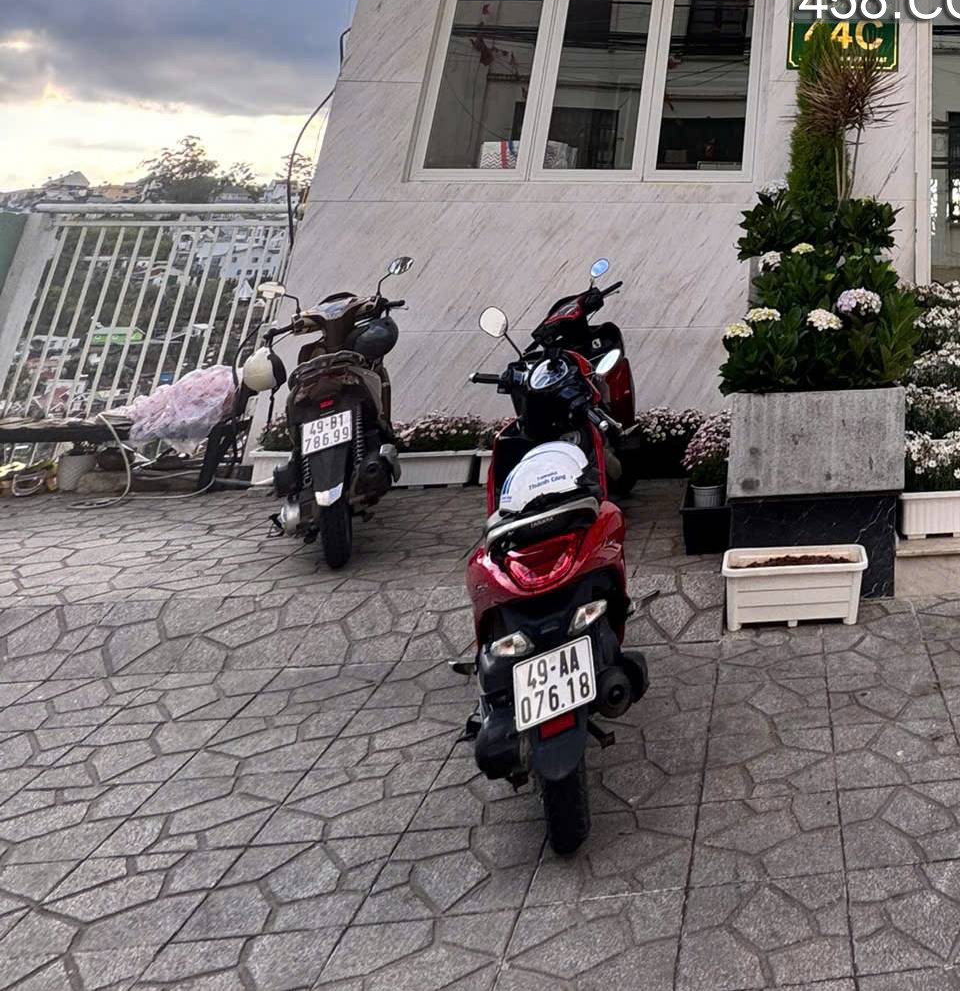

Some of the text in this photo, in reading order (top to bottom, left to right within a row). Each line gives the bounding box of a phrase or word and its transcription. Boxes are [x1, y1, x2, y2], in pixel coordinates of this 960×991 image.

[304, 426, 349, 453] 786.99
[309, 413, 344, 436] 49-B1
[527, 645, 580, 690] 49-AA
[520, 671, 590, 724] 076.18
